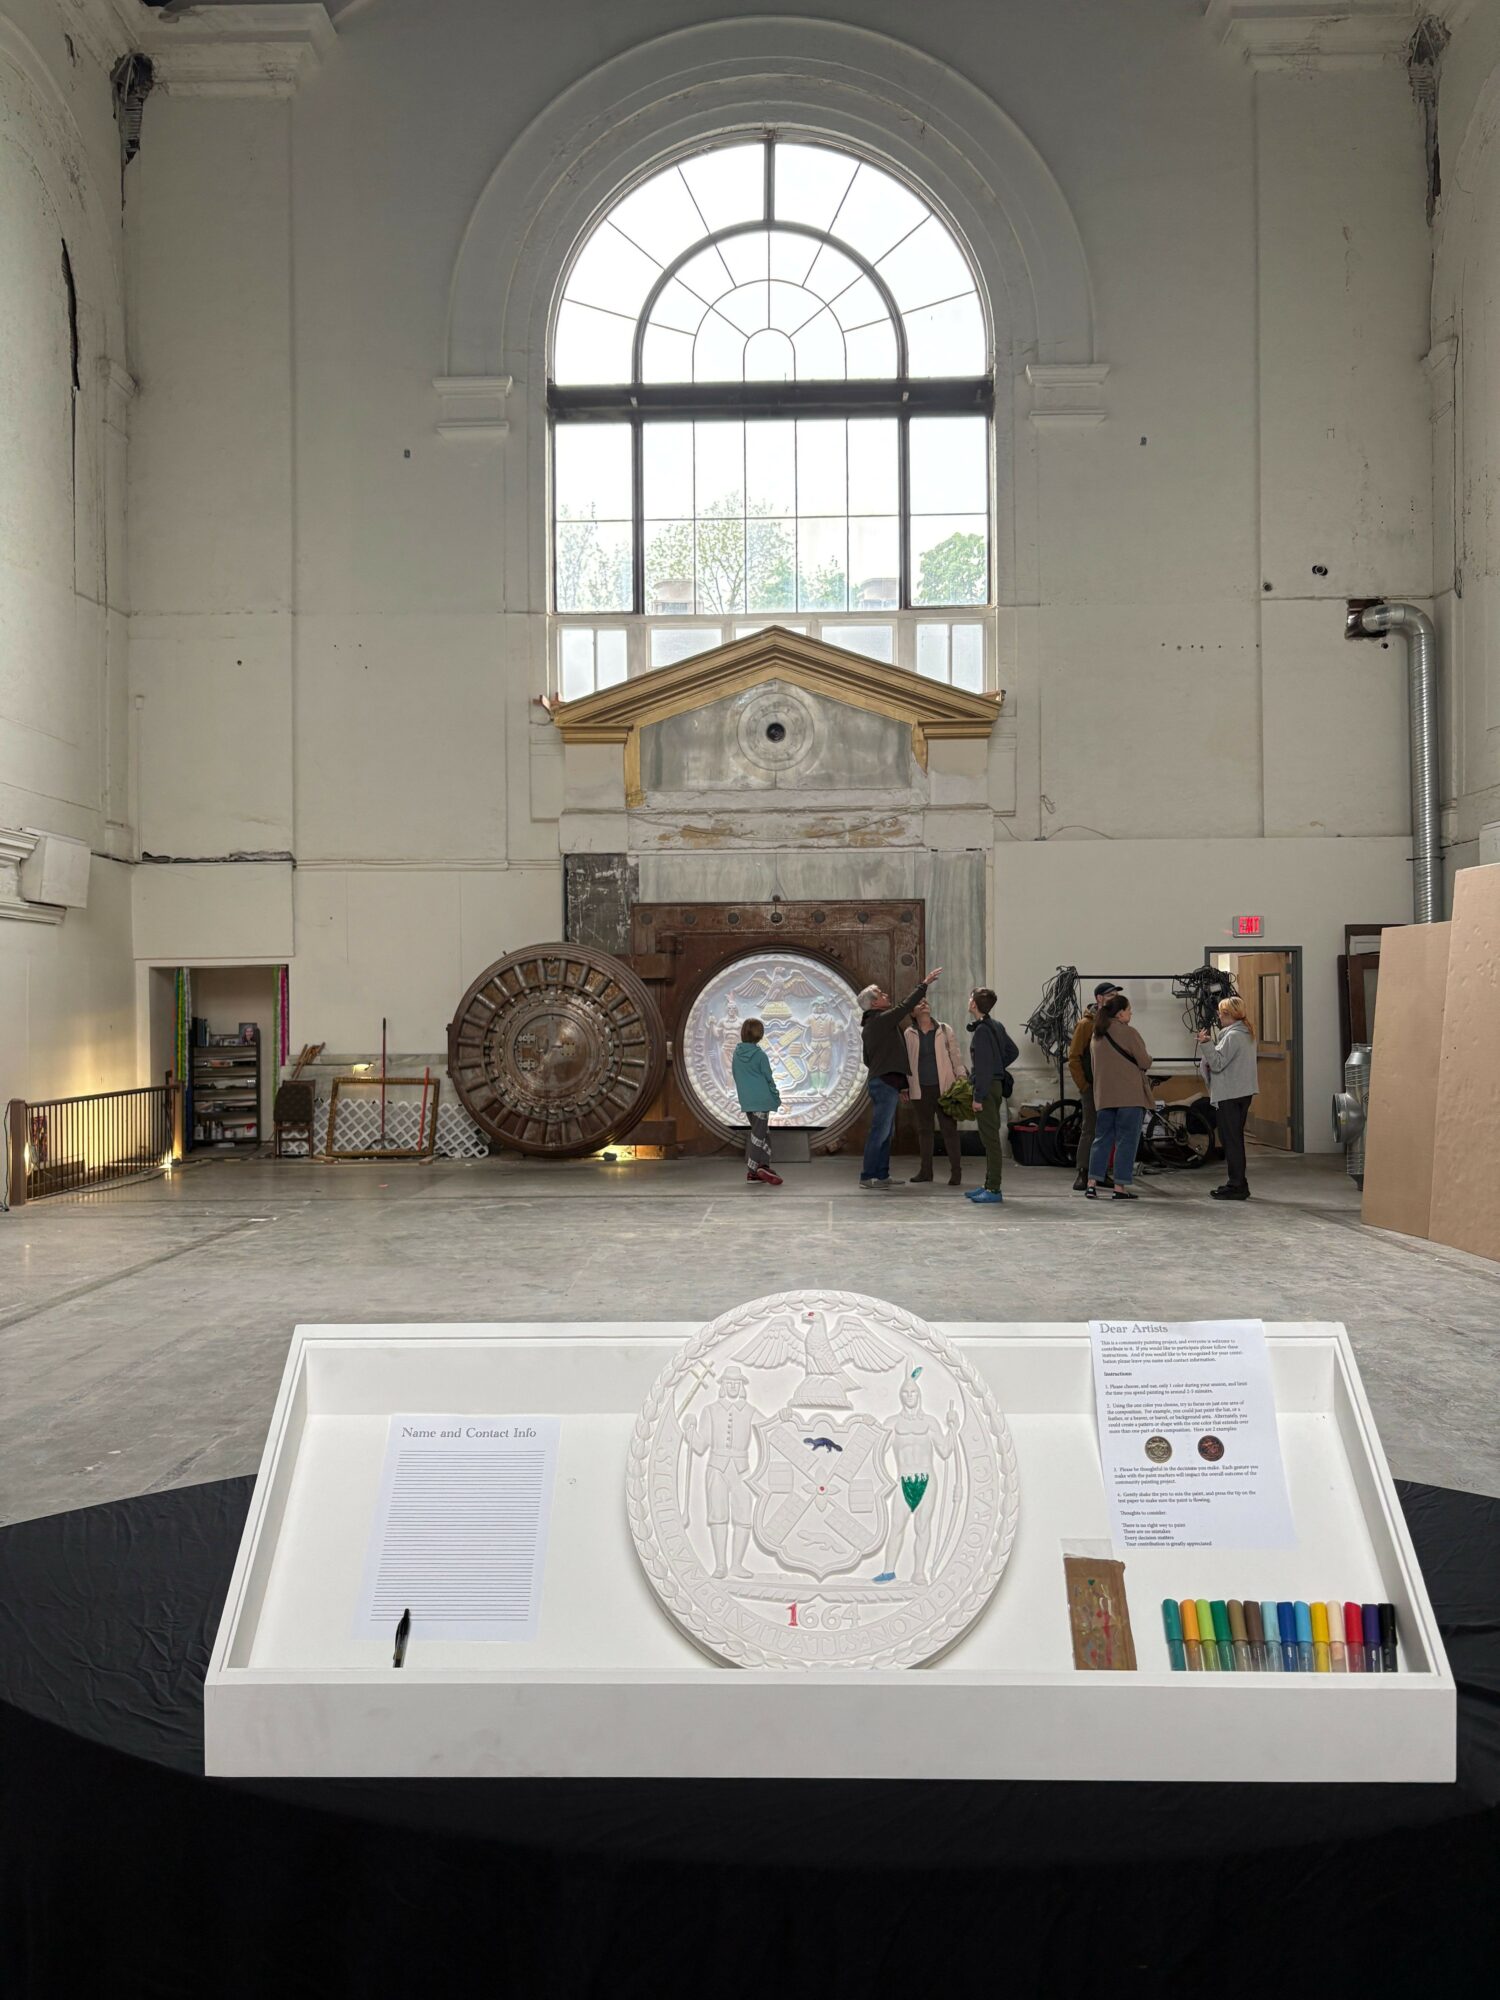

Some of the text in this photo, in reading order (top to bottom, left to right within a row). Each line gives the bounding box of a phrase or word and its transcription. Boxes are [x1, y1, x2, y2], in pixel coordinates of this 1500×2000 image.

[1238, 916, 1261, 934] EXIT
[1099, 1323, 1168, 1333] Dear Artists
[401, 1427, 537, 1438] Name and Contact Info
[785, 1599, 861, 1631] 1664
